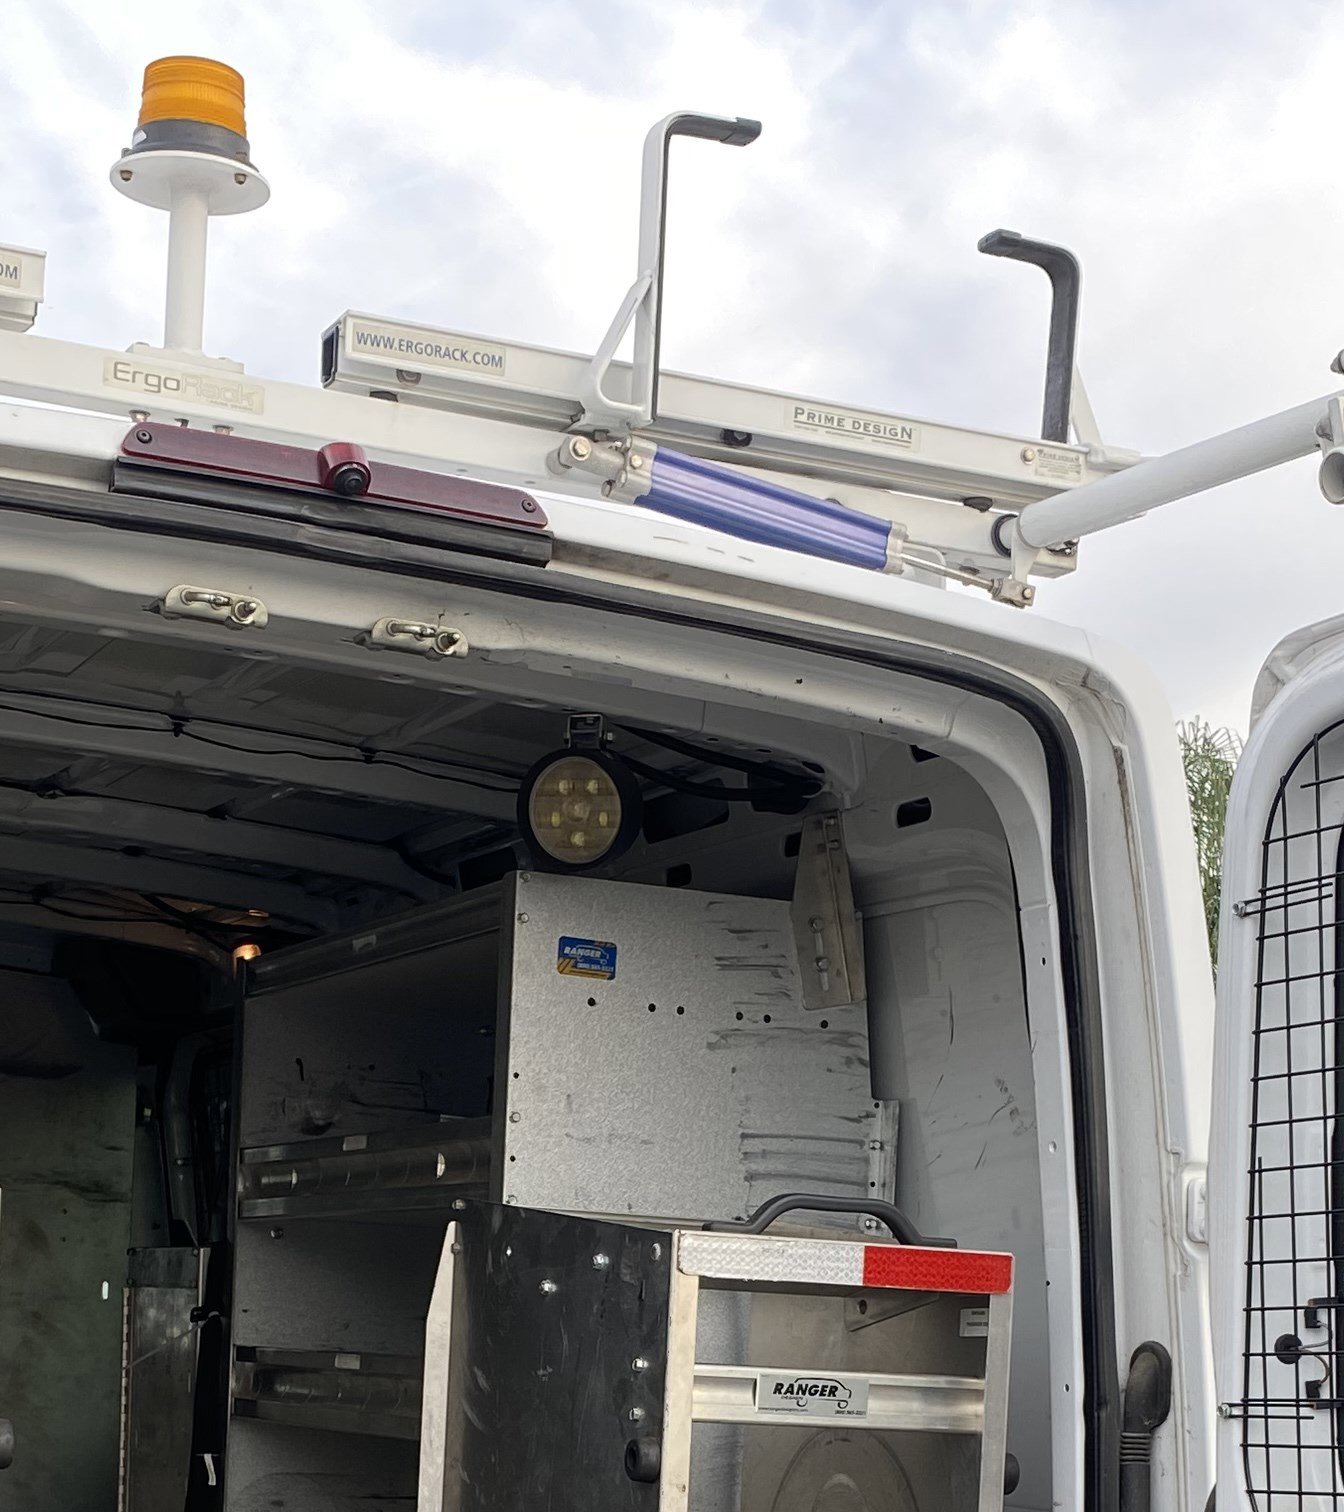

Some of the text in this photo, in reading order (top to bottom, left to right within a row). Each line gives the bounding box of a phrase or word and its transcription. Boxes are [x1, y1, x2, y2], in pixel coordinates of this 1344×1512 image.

[356, 331, 503, 369] WWW.ERGORACK.COM
[794, 406, 845, 428] PRIME
[852, 420, 912, 440] DESIGN
[773, 1382, 838, 1398] RANGER
